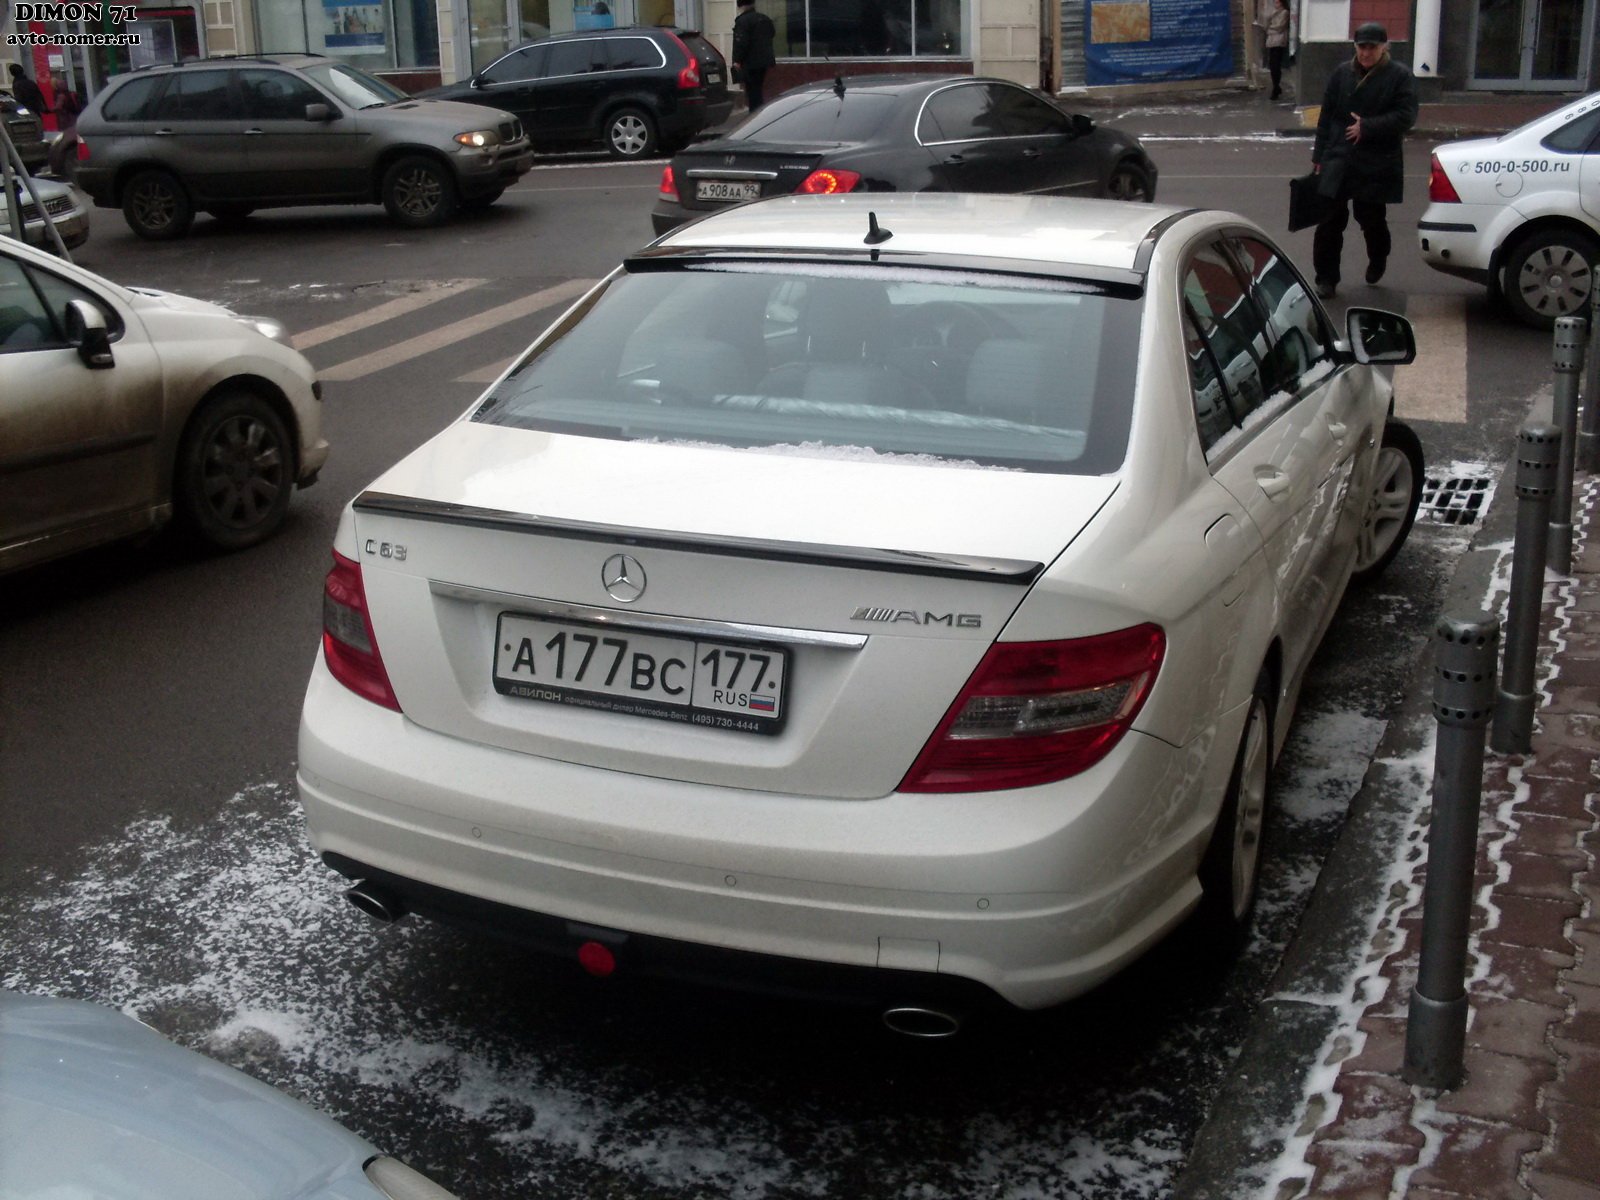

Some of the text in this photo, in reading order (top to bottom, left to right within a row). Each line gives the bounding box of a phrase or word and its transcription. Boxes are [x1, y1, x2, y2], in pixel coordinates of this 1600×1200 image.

[1474, 159, 1570, 174] 500-0-500.ru
[365, 538, 408, 562] C63
[890, 609, 982, 628] AMG
[511, 631, 771, 696] А177ВС 177
[509, 686, 562, 702] АВИЛОН
[634, 705, 690, 721] Mercedes-Benz
[692, 713, 715, 725] (495)
[716, 717, 761, 731] 730-4444
[712, 690, 749, 708] RUS
